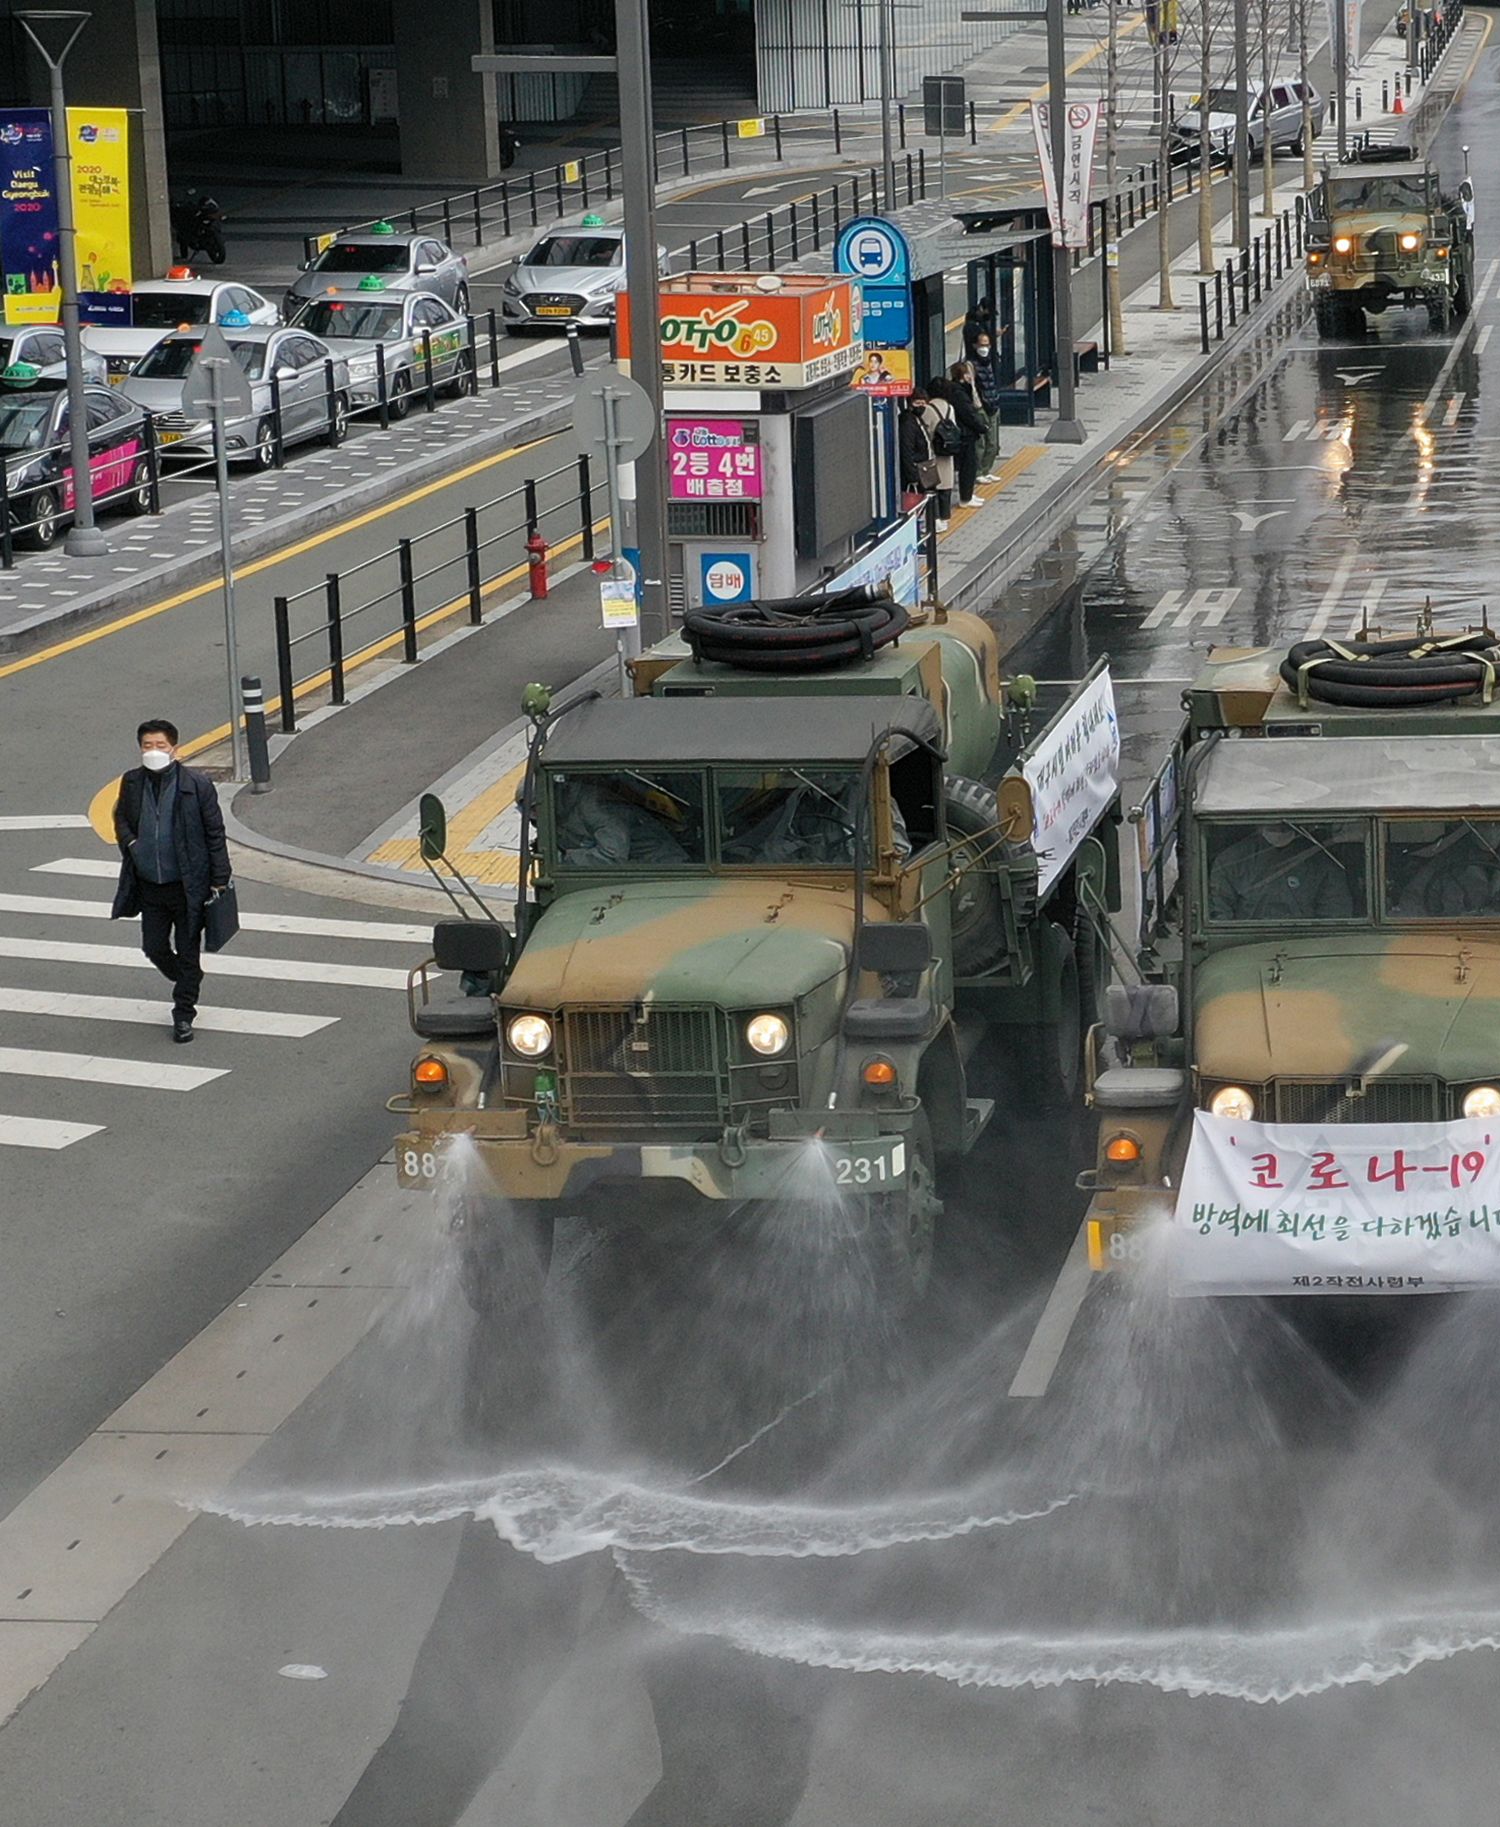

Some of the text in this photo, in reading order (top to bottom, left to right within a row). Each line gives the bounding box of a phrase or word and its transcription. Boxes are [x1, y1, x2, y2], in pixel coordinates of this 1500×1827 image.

[12, 169, 35, 179] Visit
[77, 165, 102, 174] 2020
[10, 180, 39, 190] Daegu
[1, 190, 50, 200] Gyeongbuk
[14, 203, 42, 212] 2020
[661, 317, 769, 352] OTTO 6 45
[662, 364, 716, 383] 통카드
[724, 364, 782, 384] 보충소
[673, 446, 755, 478] 2등 4번
[686, 478, 743, 496] 배출점
[709, 572, 742, 589] 담배
[835, 1155, 886, 1184] 231
[1192, 1202, 1270, 1237] 방역에
[1276, 1209, 1351, 1242] 최선을
[1291, 1275, 1426, 1289] 제2작전사령부
